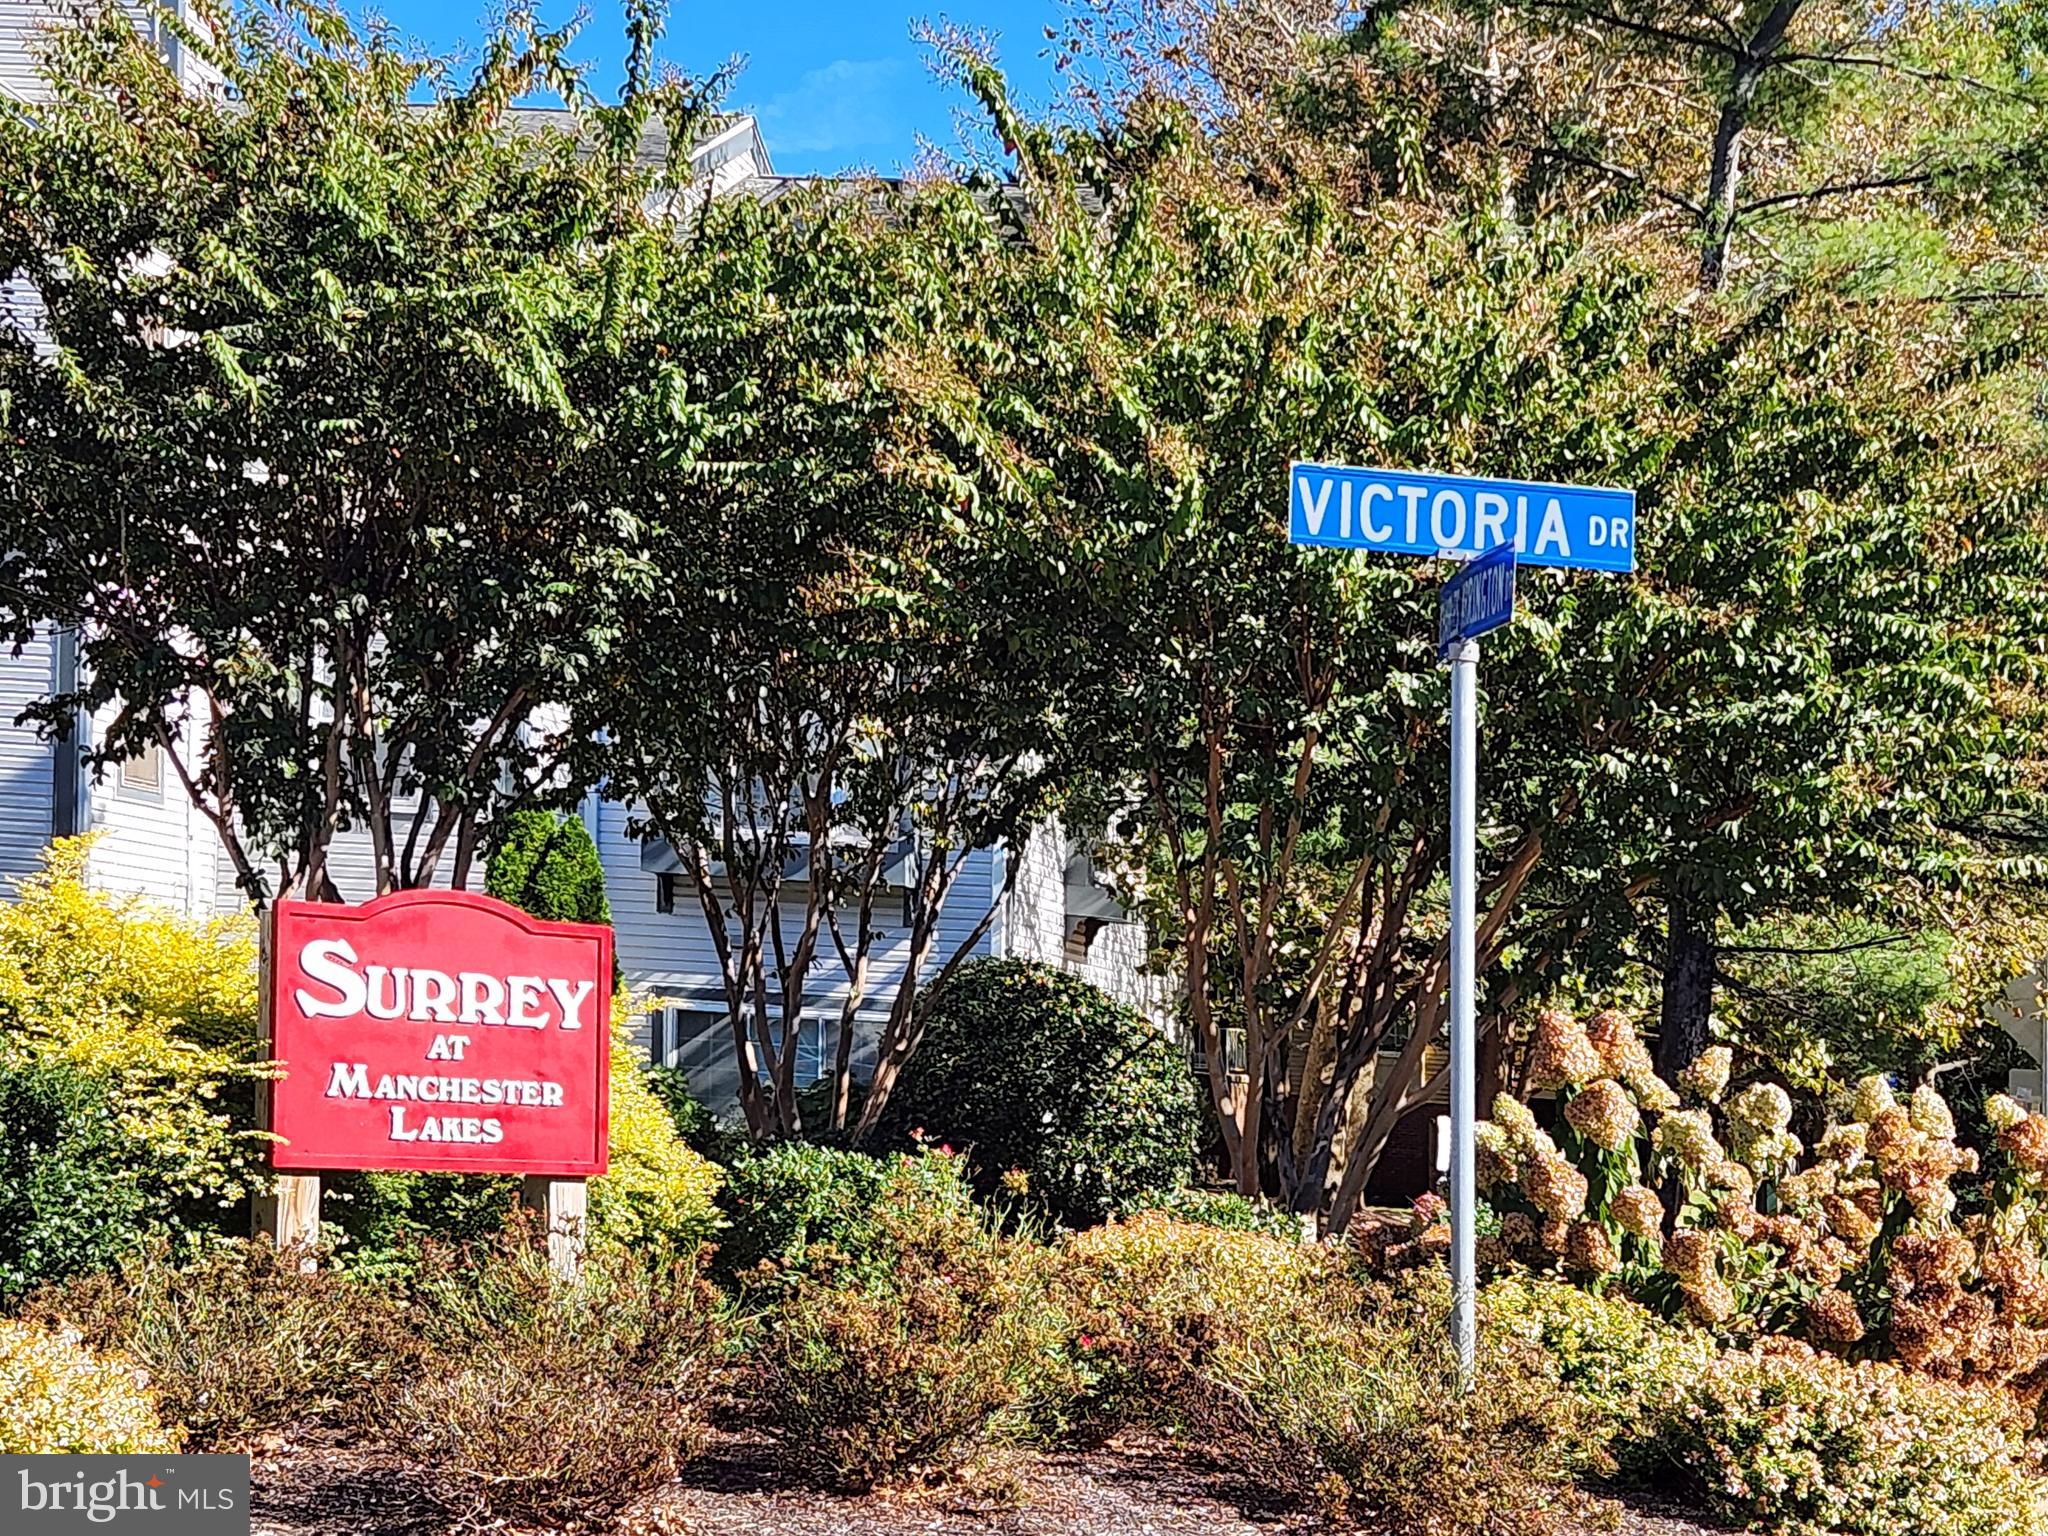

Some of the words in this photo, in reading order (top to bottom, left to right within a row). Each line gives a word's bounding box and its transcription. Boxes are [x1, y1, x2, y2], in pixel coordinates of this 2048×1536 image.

[1297, 476, 1571, 557] VICTORIA
[1588, 515, 1629, 549] DR
[295, 938, 594, 1031] SURREY
[426, 1034, 471, 1061] AT
[326, 1062, 564, 1107] MANCHESTER
[389, 1106, 504, 1144] LAKES
